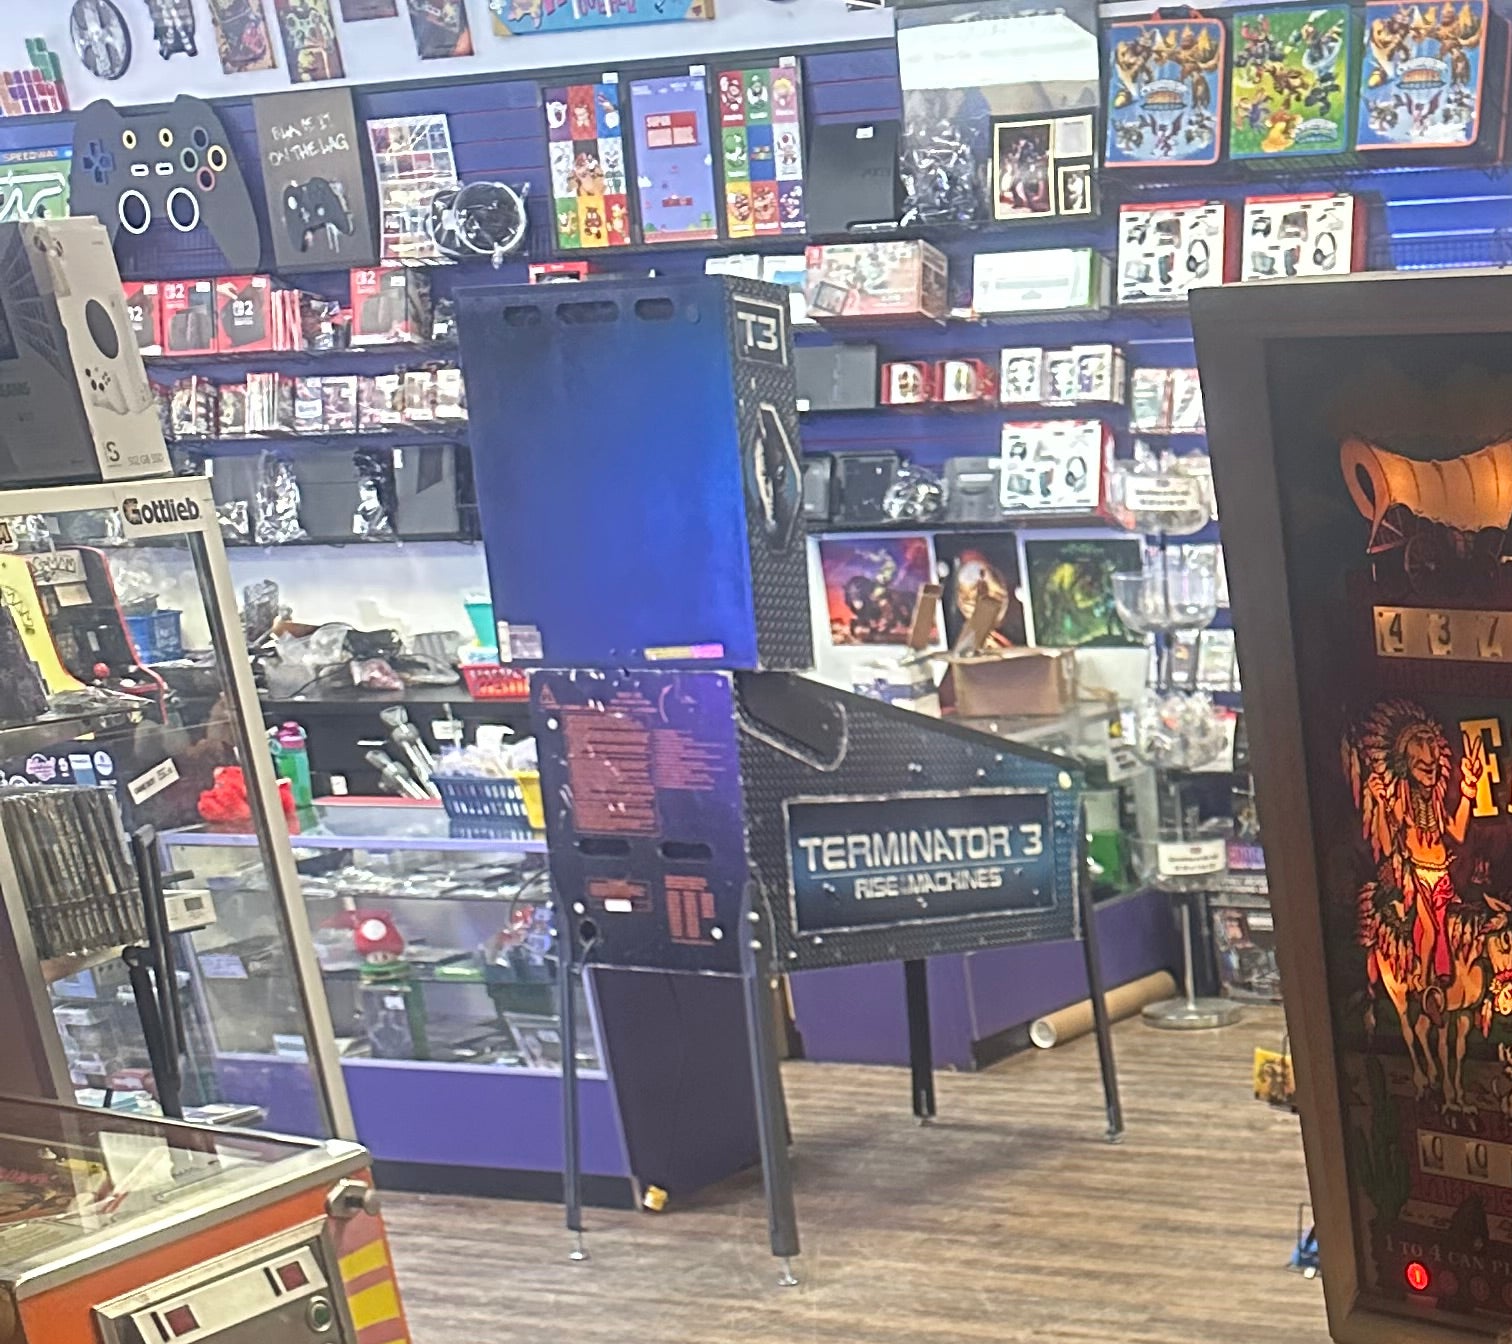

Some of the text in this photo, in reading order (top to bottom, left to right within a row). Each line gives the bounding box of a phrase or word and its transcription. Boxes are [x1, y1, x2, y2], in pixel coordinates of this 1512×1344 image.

[290, 141, 319, 160] THE
[318, 133, 349, 155] LAG
[737, 308, 778, 350] T3
[123, 497, 200, 525] Gottlieb
[798, 823, 1043, 872] TERMINATOR 3
[854, 867, 1005, 900] RISE MACHINES
[1399, 1240, 1423, 1259] TO
[1430, 1243, 1442, 1263] 4
[1448, 1250, 1485, 1271] CAN
